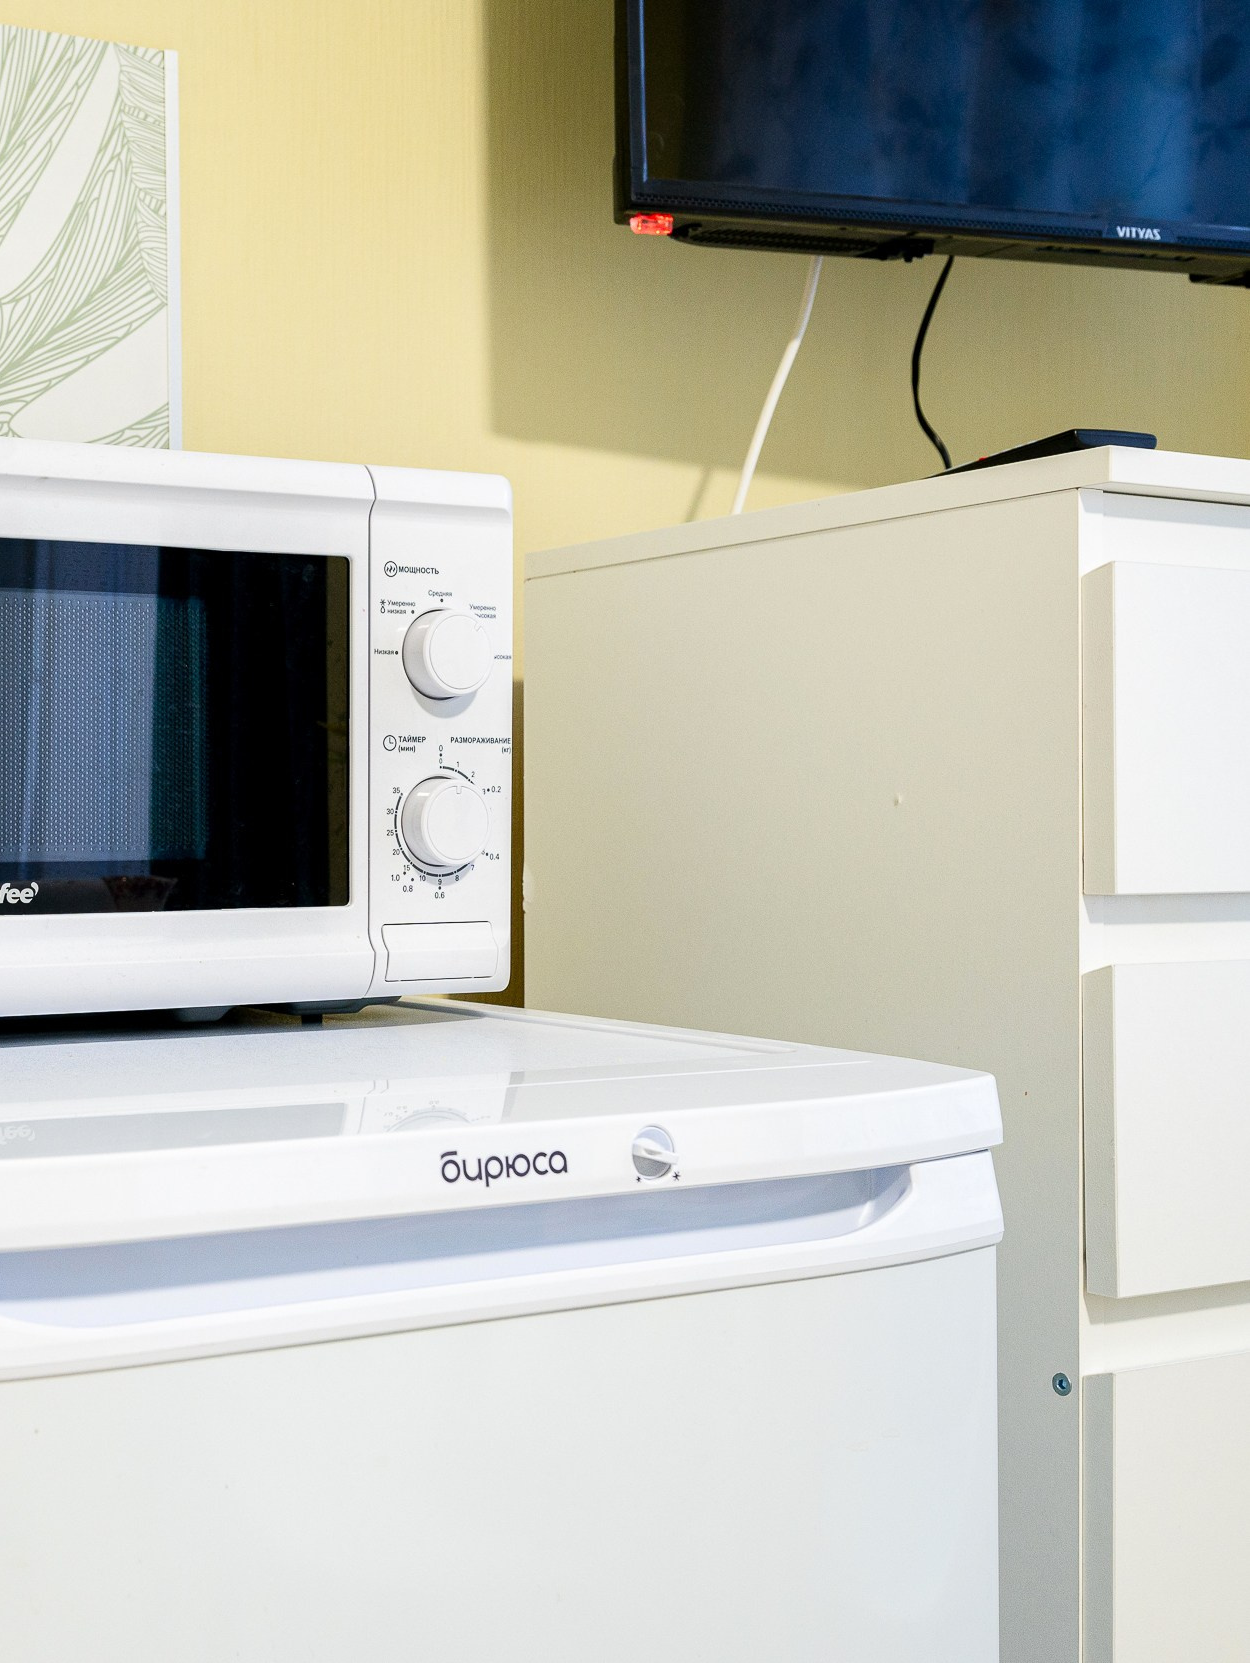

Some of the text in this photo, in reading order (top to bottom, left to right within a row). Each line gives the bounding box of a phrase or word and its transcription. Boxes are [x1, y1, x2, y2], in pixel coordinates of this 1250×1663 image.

[1116, 225, 1162, 241] VITYAS
[399, 566, 440, 575] МОЩНОСТЬ
[398, 735, 427, 744] ТАЙМЕР
[450, 736, 511, 744] РАЗМОРАЖИВАНИЕ
[441, 1150, 568, 1187] бирюса
